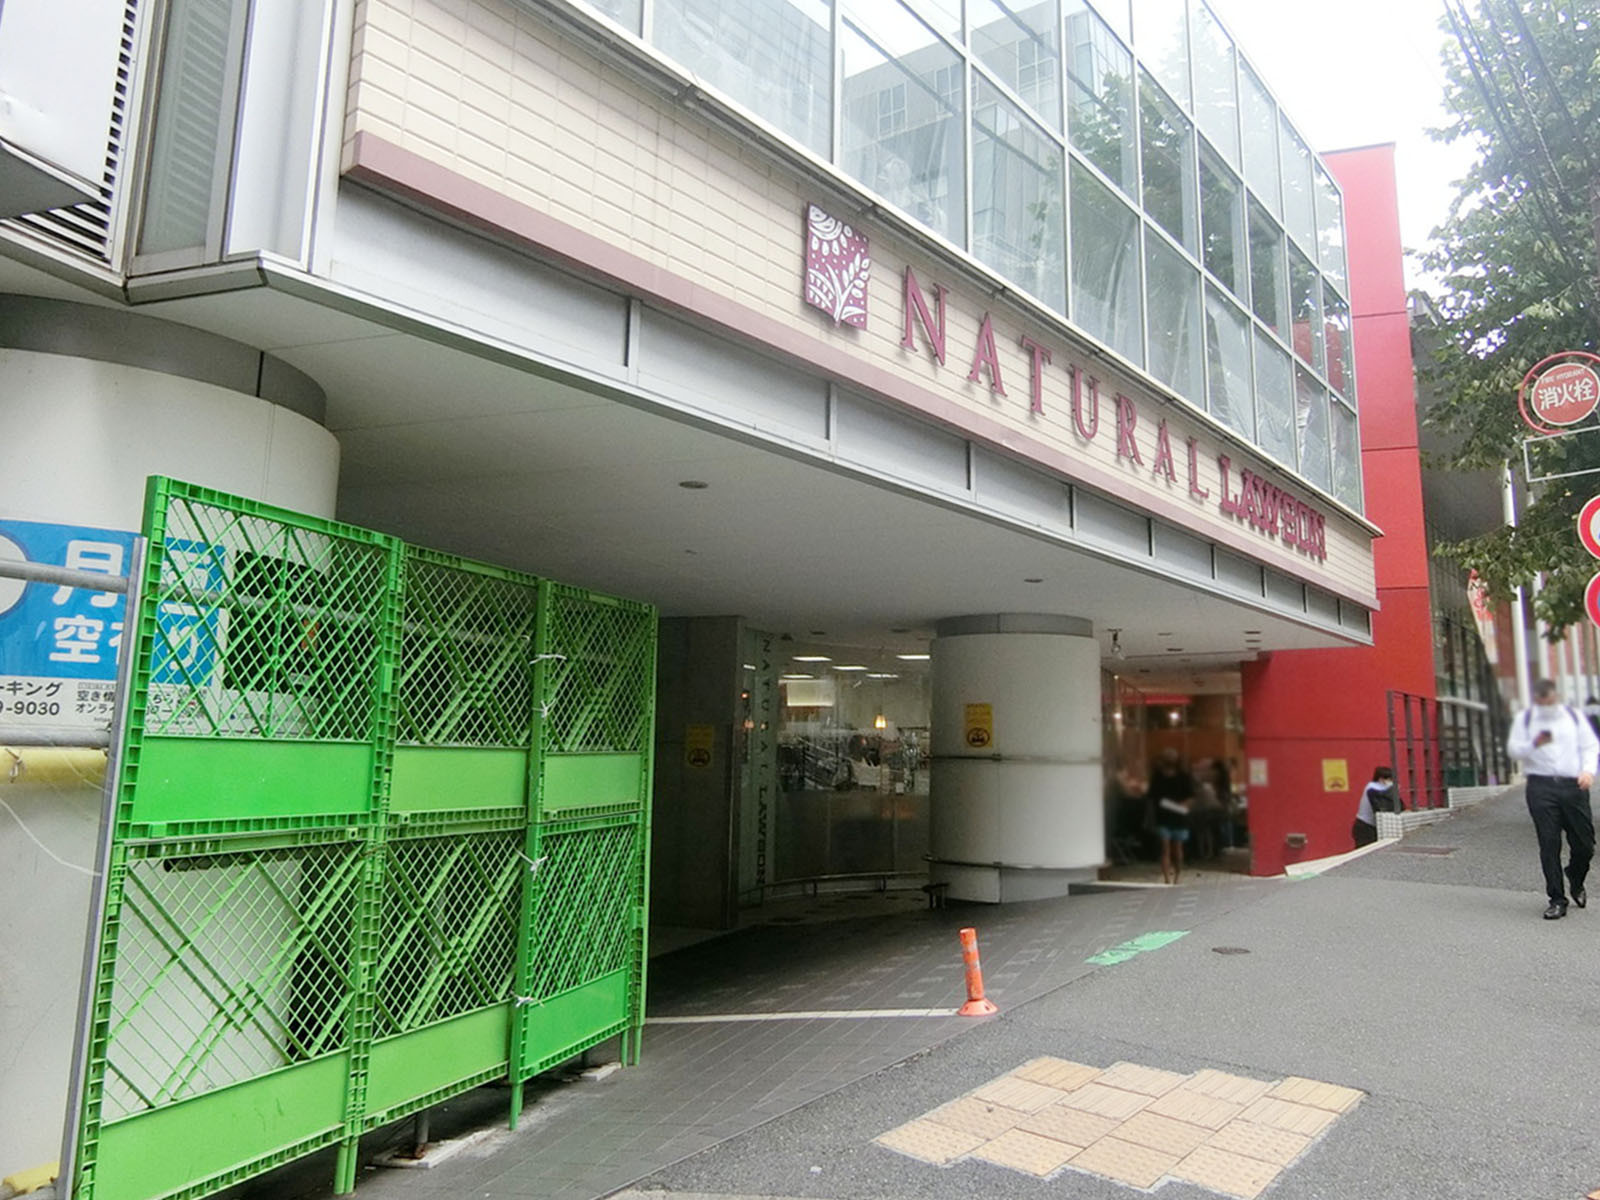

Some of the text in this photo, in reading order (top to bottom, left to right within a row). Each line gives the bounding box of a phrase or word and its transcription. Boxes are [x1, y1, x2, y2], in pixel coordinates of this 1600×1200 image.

[1538, 377, 1595, 411] 消火栓
[901, 265, 1328, 561] NATURAL LAWSON
[0, 681, 63, 697] キング
